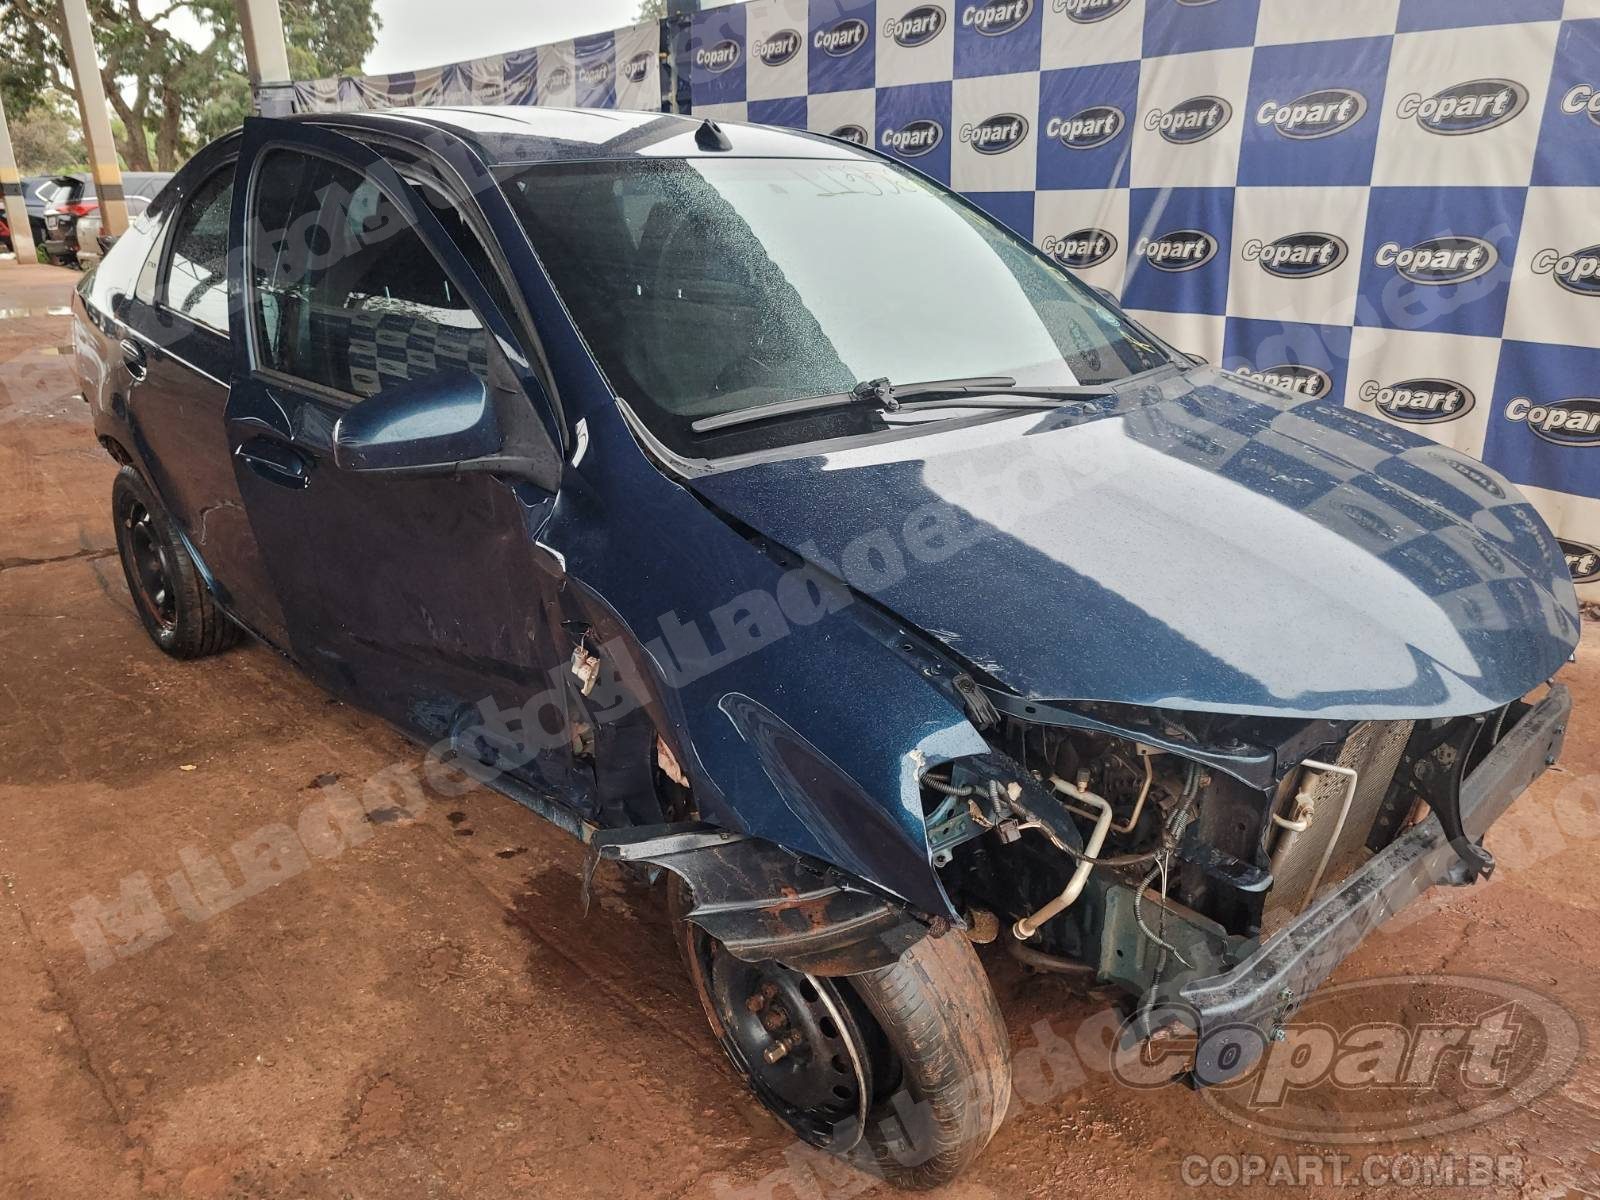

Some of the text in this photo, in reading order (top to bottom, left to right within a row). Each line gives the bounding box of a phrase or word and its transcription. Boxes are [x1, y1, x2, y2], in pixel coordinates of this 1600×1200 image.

[963, 2, 1024, 28] Copart
[814, 27, 861, 51] Copart
[883, 16, 937, 42] Copart
[697, 46, 736, 66] Copart
[752, 35, 796, 60] Copart
[1256, 93, 1353, 129] Copart
[1396, 86, 1513, 125] Copart
[1046, 116, 1116, 139] Copart
[1144, 103, 1219, 136] Copart
[881, 129, 935, 152] Copart
[960, 122, 1022, 148] Copart
[1041, 235, 1106, 260] Copart
[1136, 236, 1207, 262] Copart
[1241, 238, 1336, 268] Copart
[1374, 241, 1485, 278] Copart
[1531, 248, 1600, 283] Cop
[1359, 379, 1461, 414] Copart
